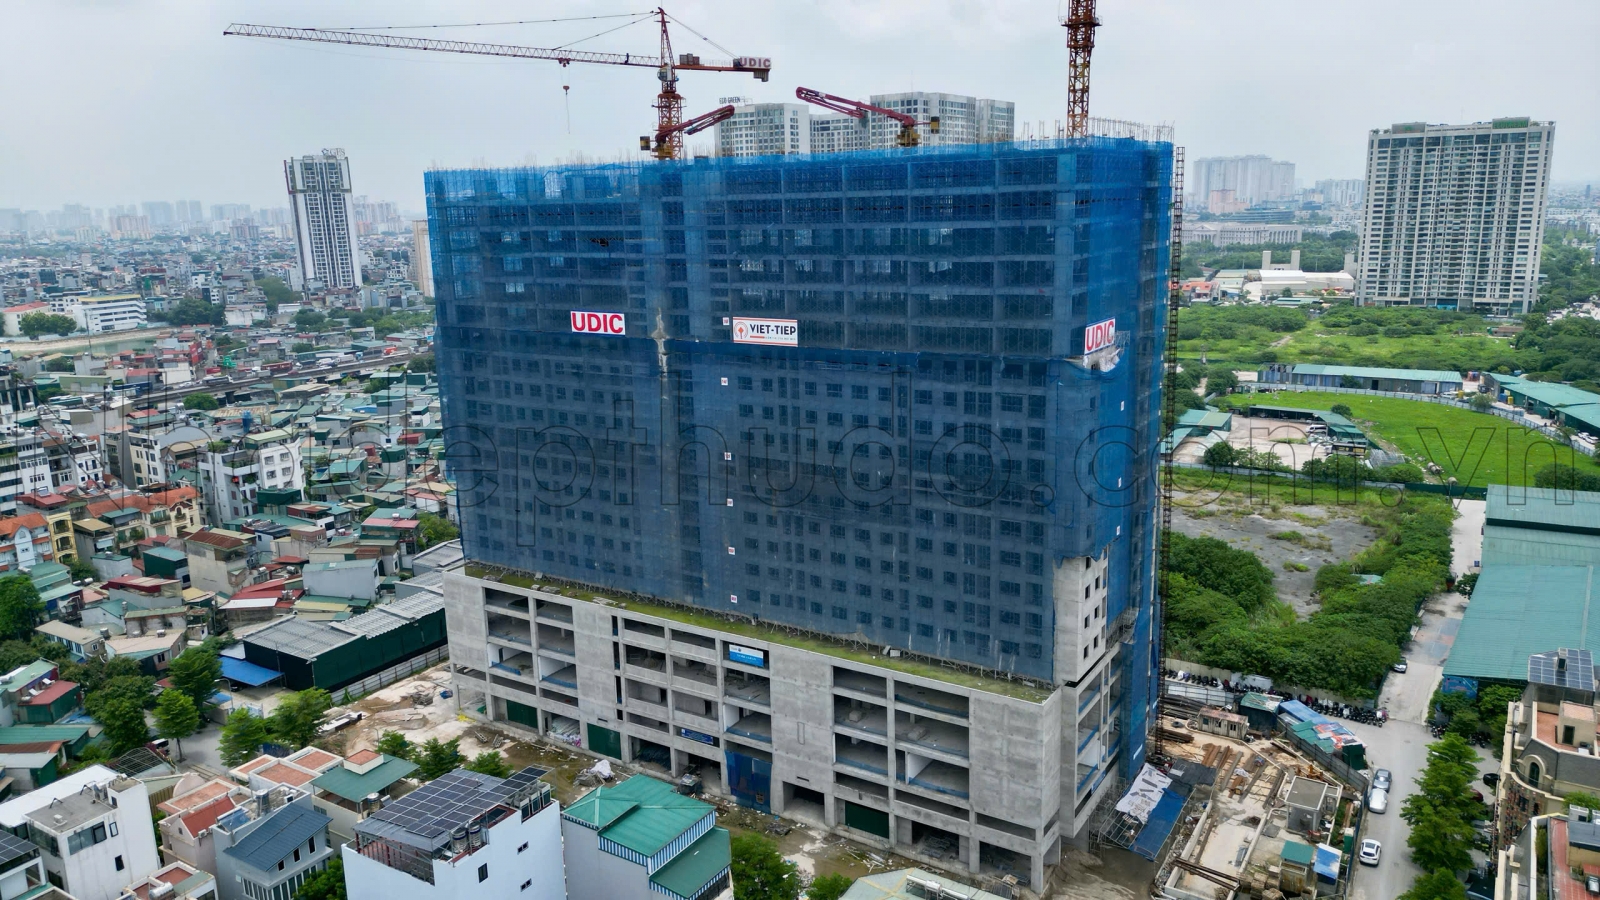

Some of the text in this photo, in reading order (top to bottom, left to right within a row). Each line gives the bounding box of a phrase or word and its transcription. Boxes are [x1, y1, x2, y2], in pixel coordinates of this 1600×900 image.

[740, 57, 770, 67] UDIC
[571, 312, 624, 334] UDIC
[750, 323, 797, 336] VIET-TIEP
[1086, 321, 1114, 351] UDIC
